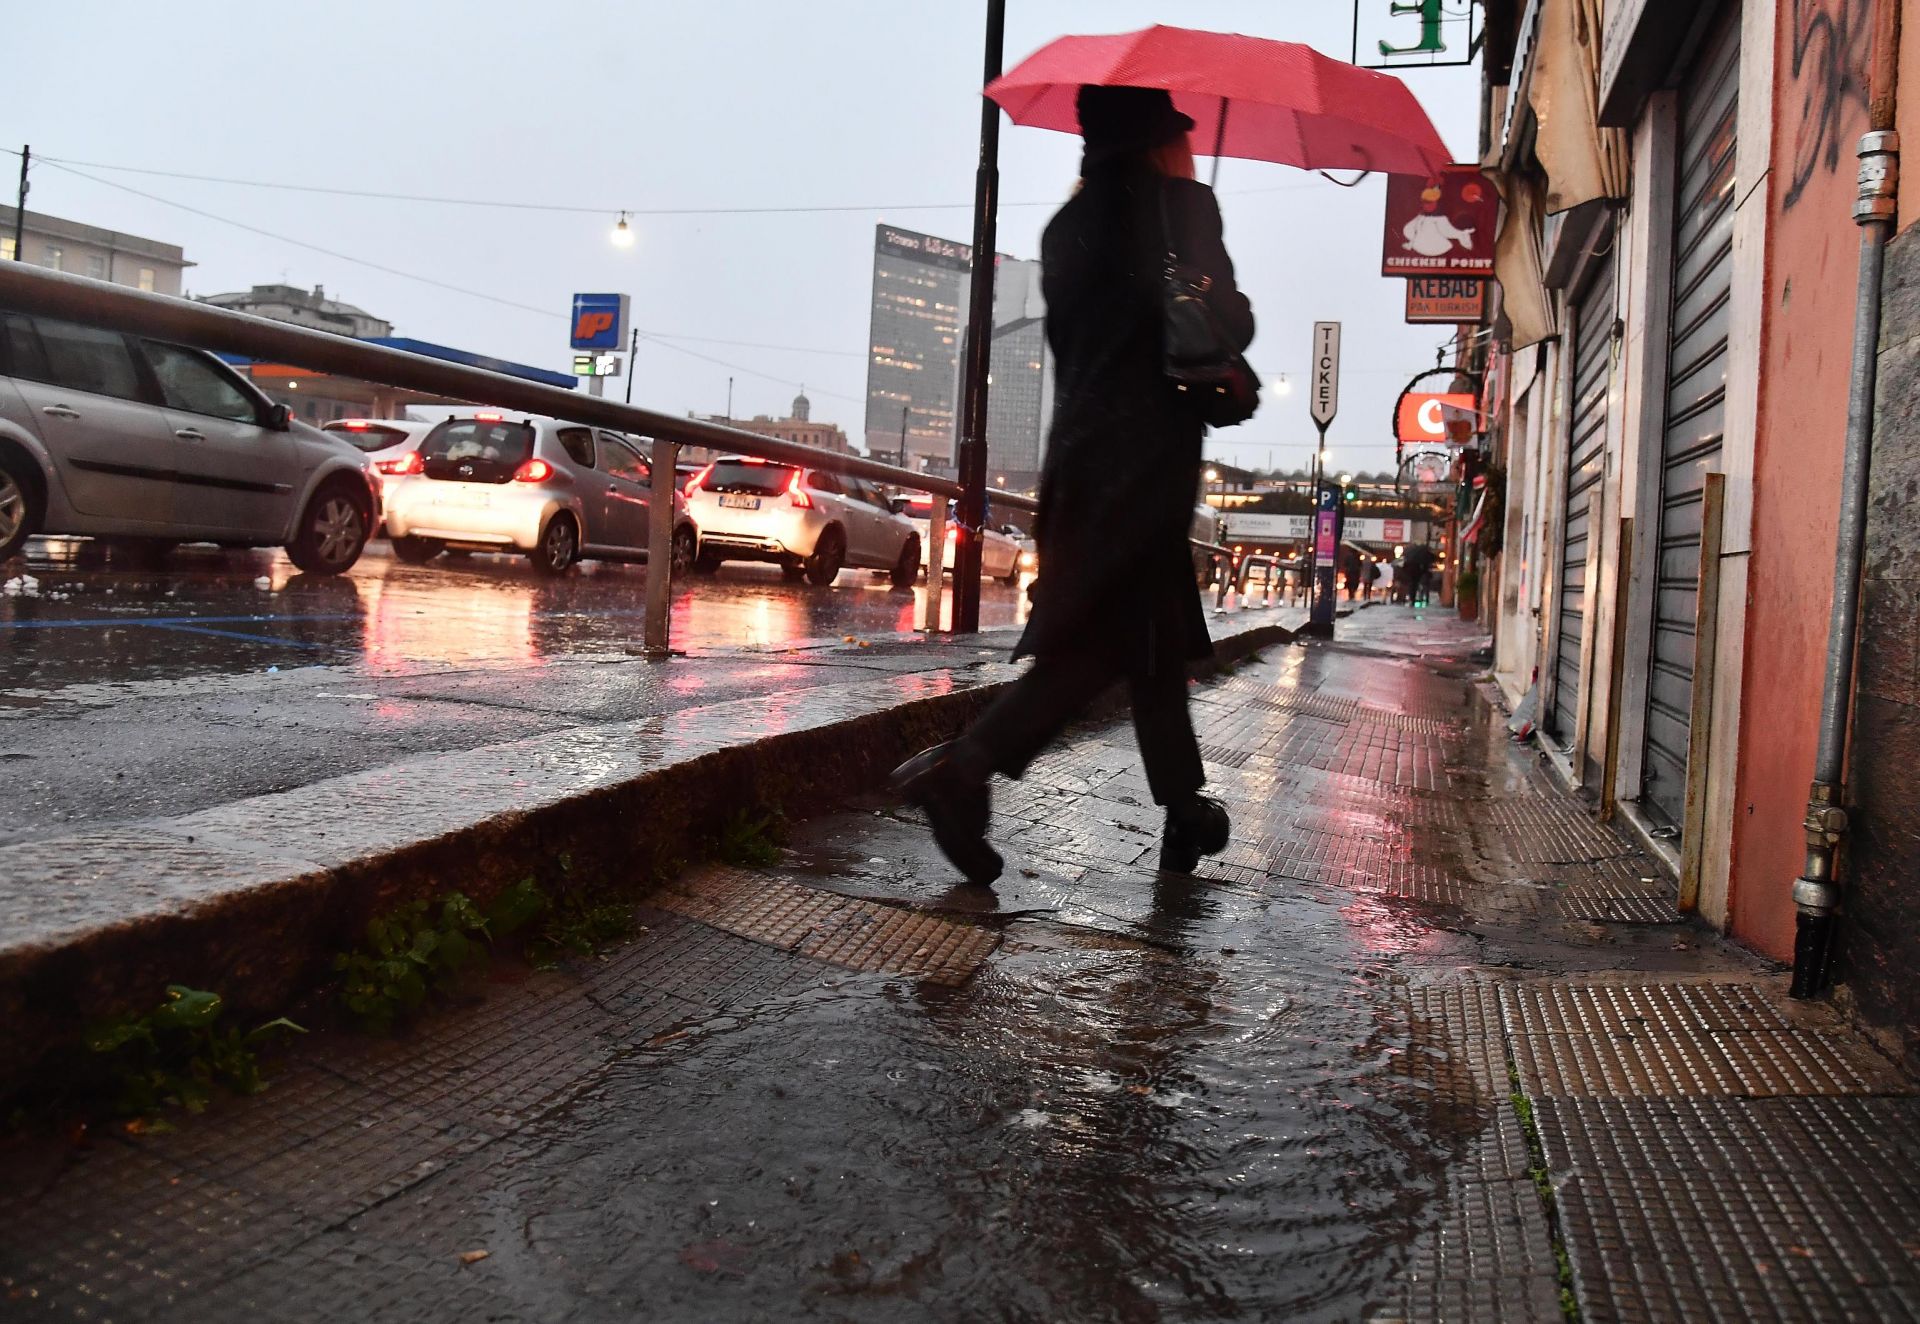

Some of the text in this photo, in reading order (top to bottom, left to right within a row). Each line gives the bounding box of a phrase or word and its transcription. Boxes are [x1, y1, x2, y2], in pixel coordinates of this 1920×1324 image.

[1386, 257, 1493, 269] CHICKEN POINT
[1411, 279, 1478, 299] KEBAB
[1435, 302, 1479, 314] TURKISH
[1319, 327, 1333, 414] TICKET
[1320, 490, 1332, 506] P
